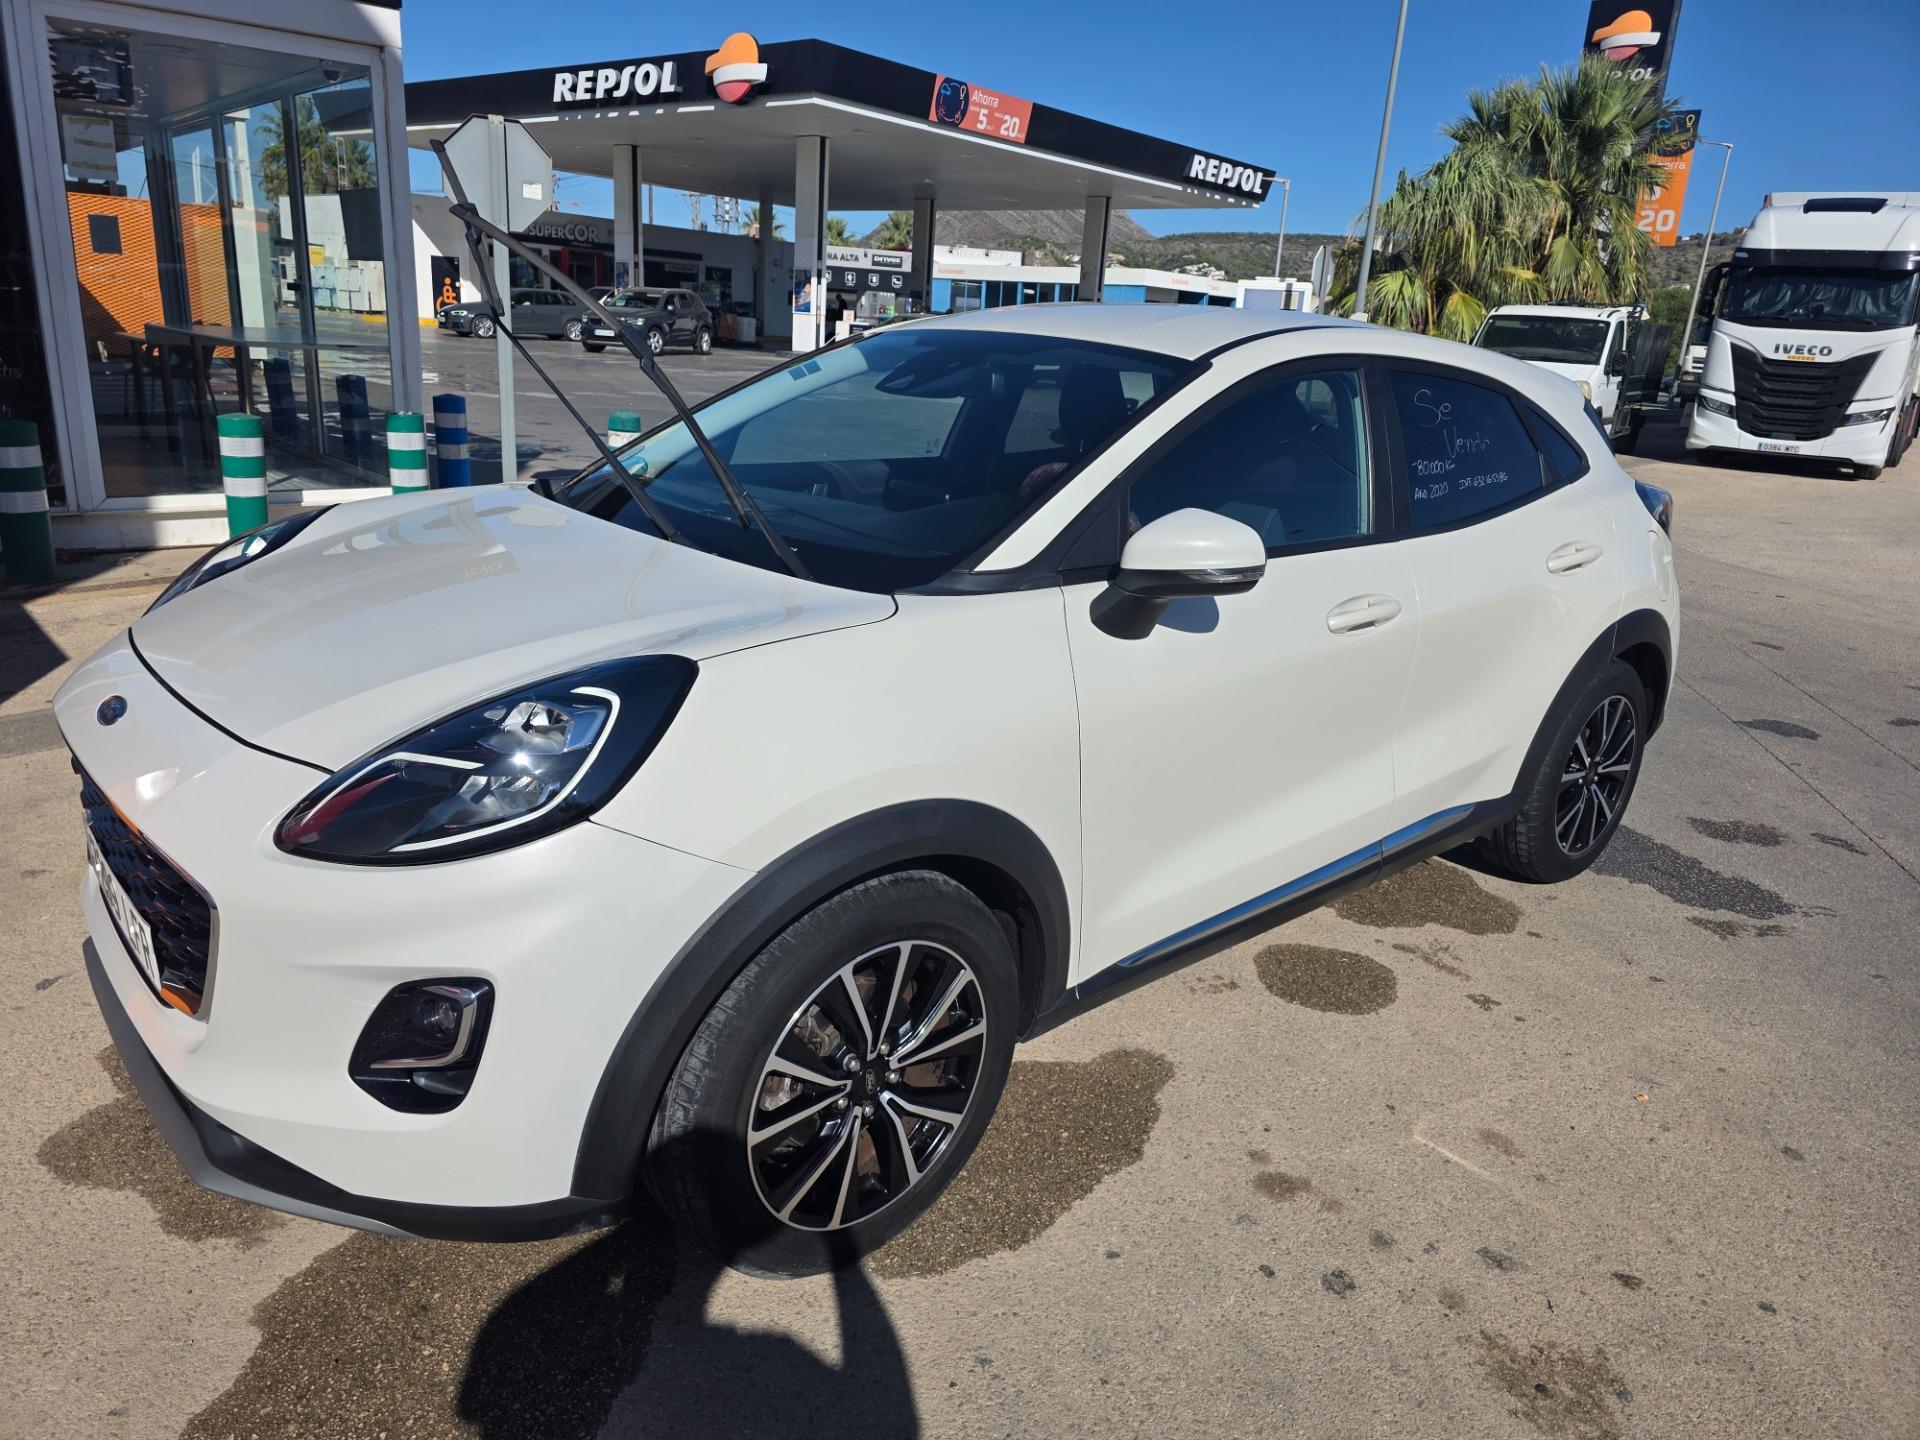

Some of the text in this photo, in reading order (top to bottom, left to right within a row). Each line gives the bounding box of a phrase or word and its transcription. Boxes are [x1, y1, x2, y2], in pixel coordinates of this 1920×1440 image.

[553, 61, 677, 103] REPSOL
[971, 90, 999, 108] Ahorra
[977, 108, 1020, 138] 5 20
[1189, 154, 1264, 194] REPSOL
[1638, 209, 1676, 232] 20
[528, 223, 599, 242] SUPERCOR
[840, 253, 860, 262] ALTA
[1774, 343, 1833, 357] IVECO
[1414, 389, 1453, 428] Se
